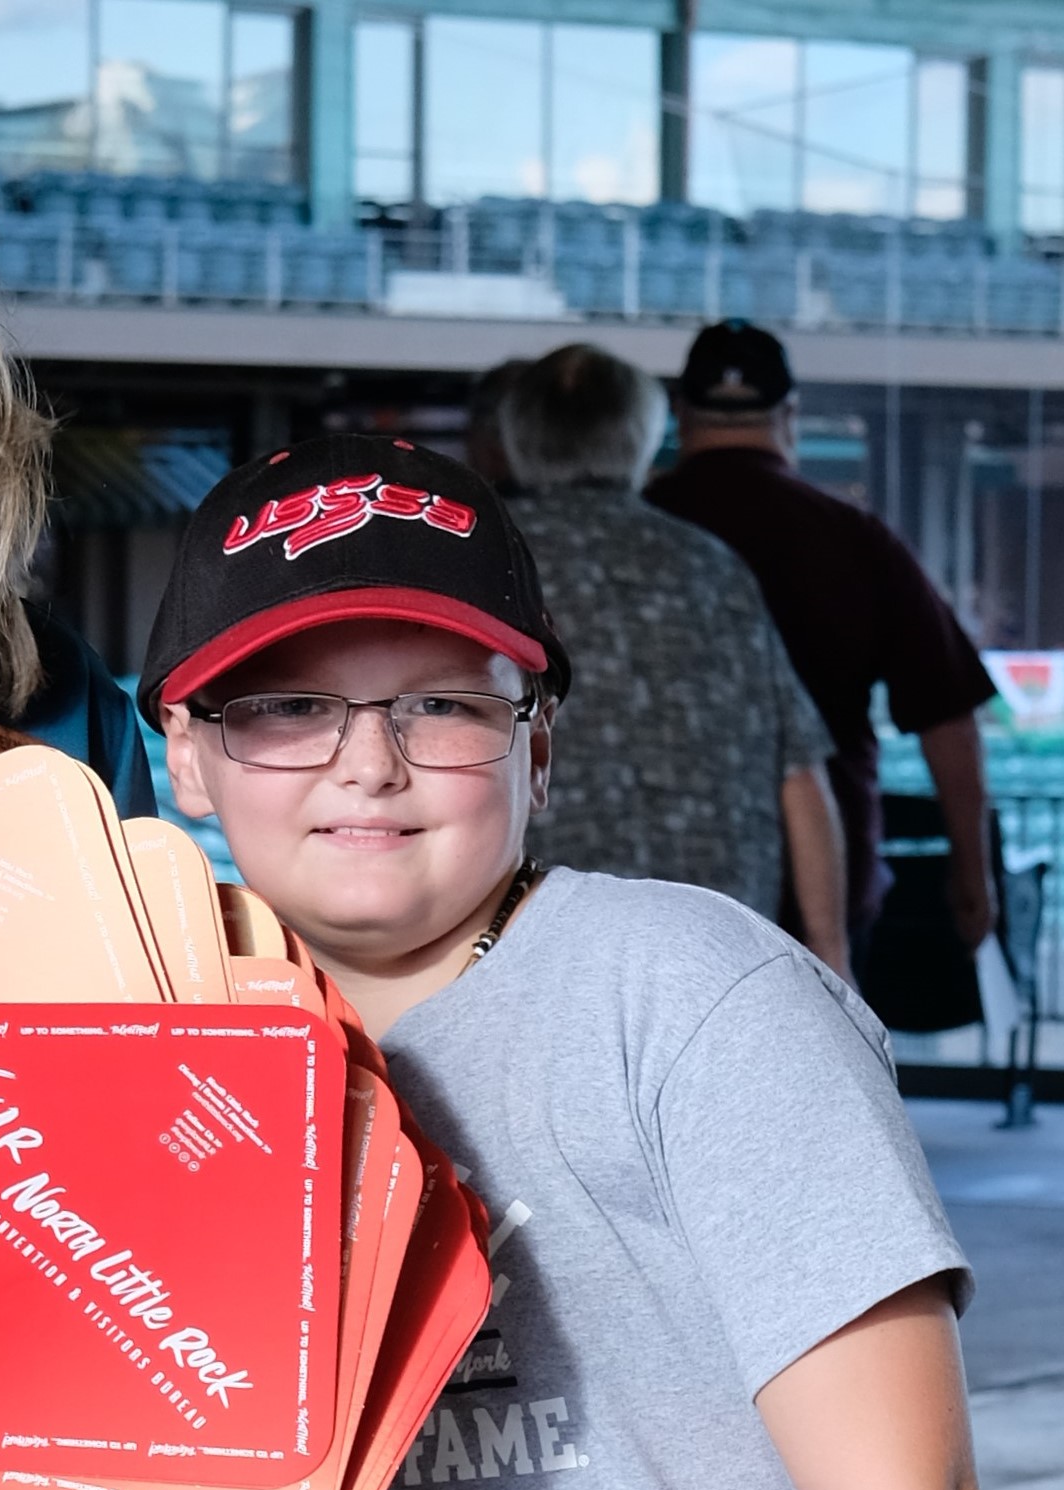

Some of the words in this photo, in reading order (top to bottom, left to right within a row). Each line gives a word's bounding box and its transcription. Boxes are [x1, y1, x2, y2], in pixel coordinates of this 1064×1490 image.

[20, 1027, 34, 1035] UP
[36, 1027, 48, 1035] TO
[307, 1040, 315, 1053] UP
[307, 1055, 315, 1066] TO
[305, 1179, 312, 1192] UP
[304, 1194, 312, 1205] TO
[301, 1321, 309, 1333] UP
[300, 1335, 308, 1348] TO
[68, 1287, 82, 1302] &
[84, 1301, 151, 1371] VISITORS
[151, 1371, 206, 1430] BUREAU
[404, 1397, 578, 1486] FAME
